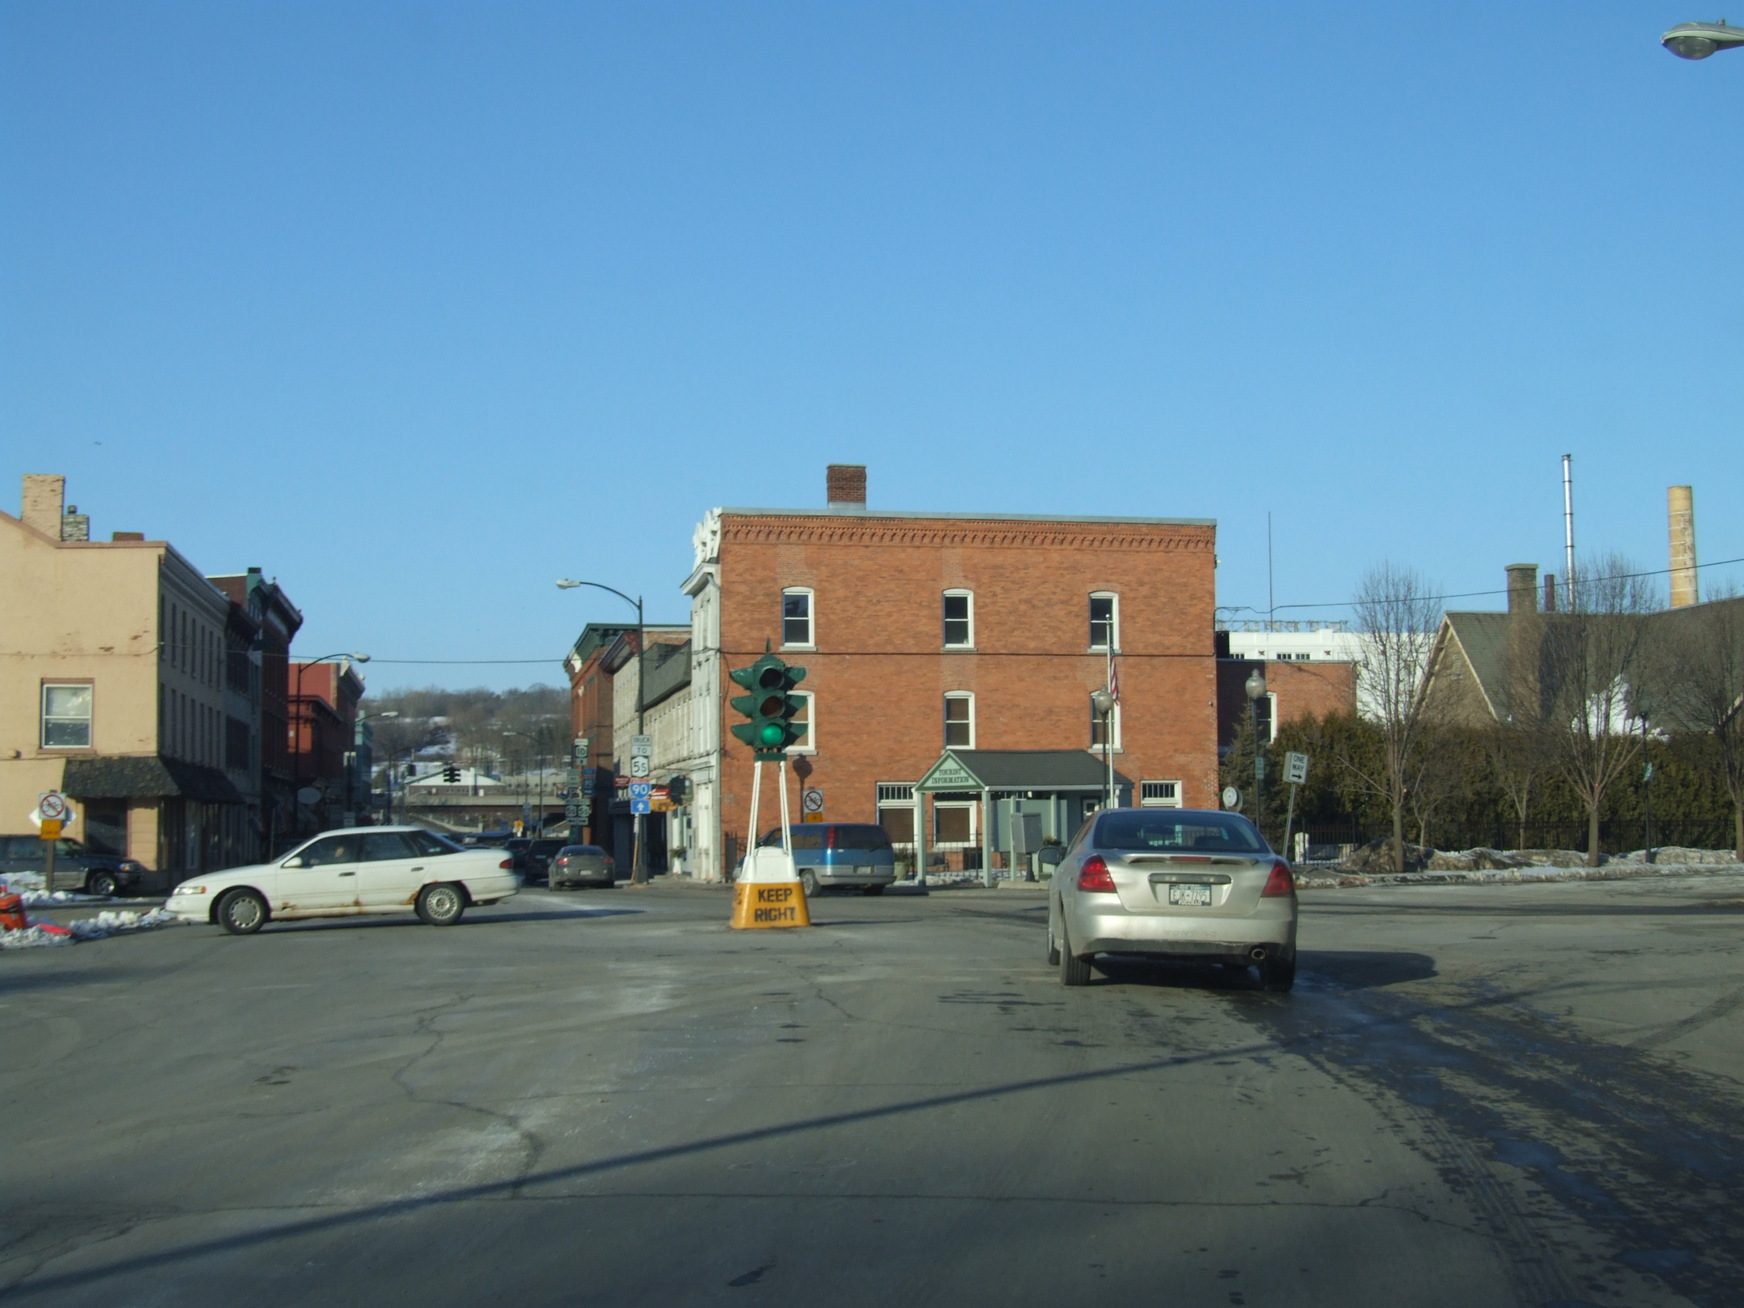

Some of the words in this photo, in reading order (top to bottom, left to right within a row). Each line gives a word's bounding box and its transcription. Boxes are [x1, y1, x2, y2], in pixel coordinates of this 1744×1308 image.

[1293, 754, 1305, 764] ONE
[939, 768, 961, 776] TOURIST
[1292, 763, 1304, 772] WAY
[932, 776, 969, 784] INFORMATION
[632, 784, 648, 795] 90
[757, 887, 793, 903] KEEP
[754, 906, 796, 922] RIGHT
